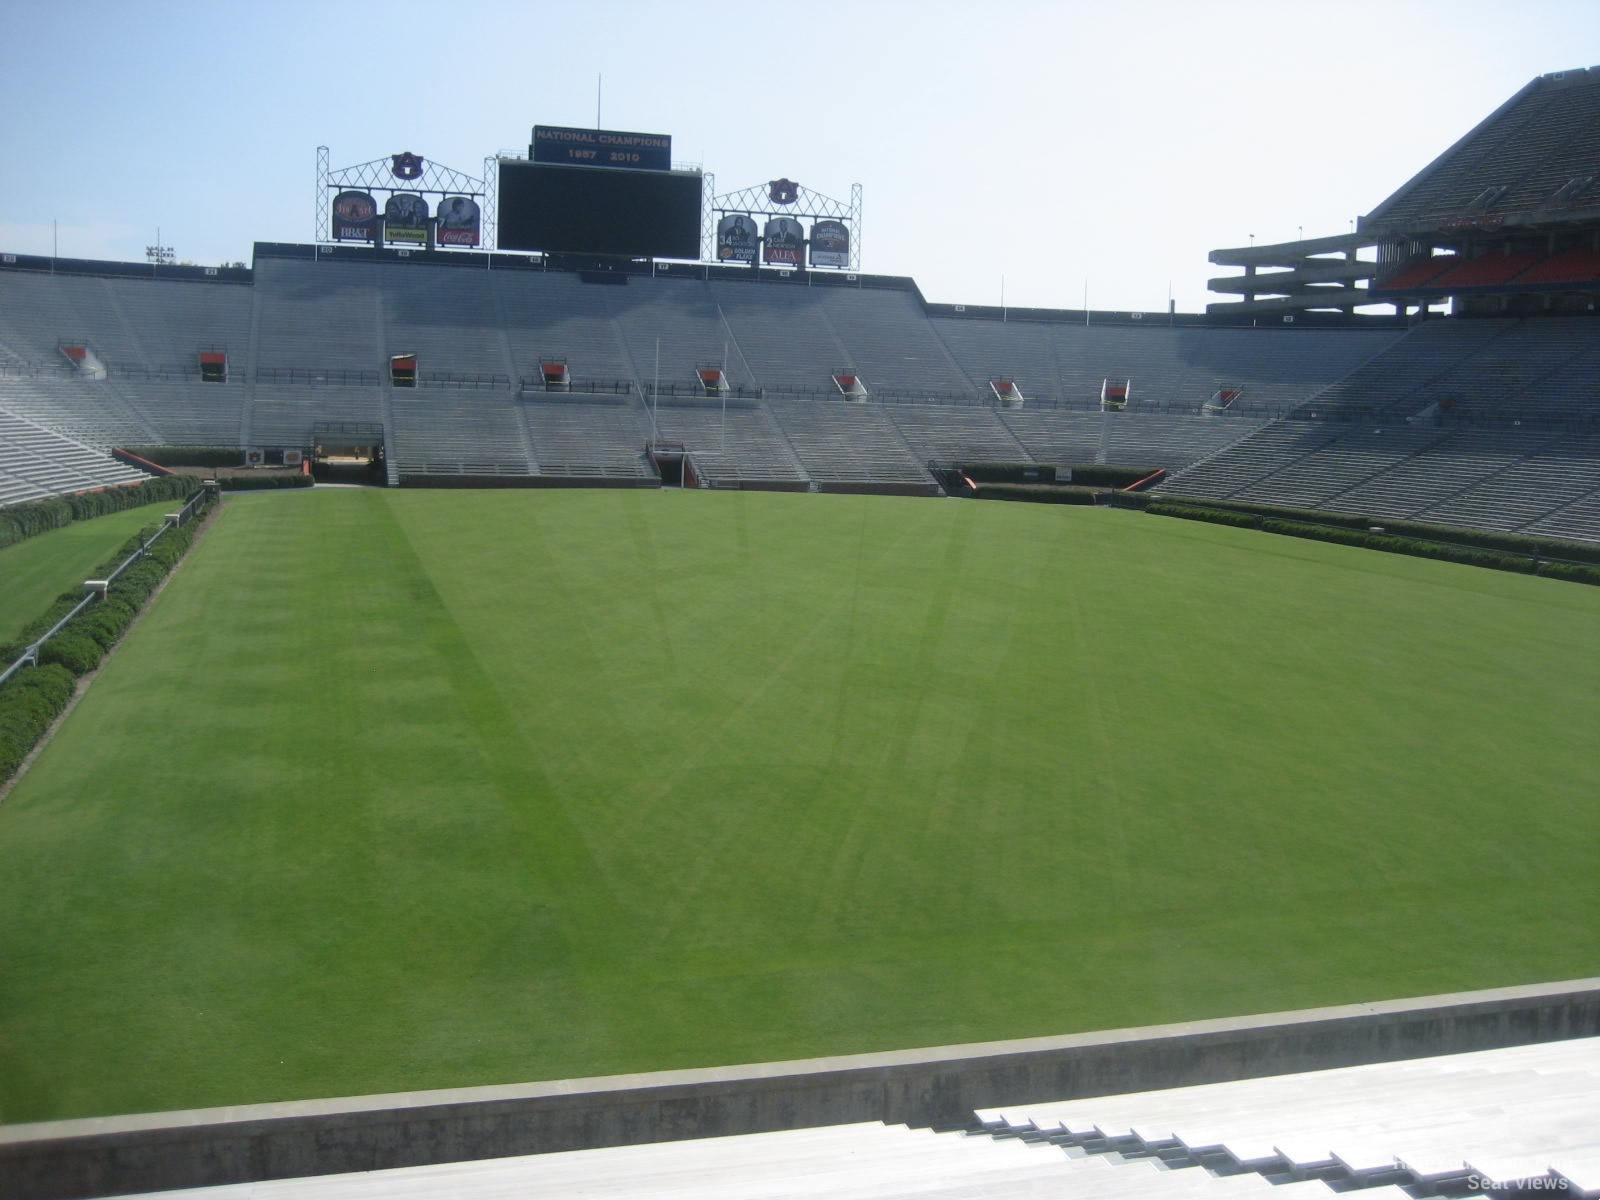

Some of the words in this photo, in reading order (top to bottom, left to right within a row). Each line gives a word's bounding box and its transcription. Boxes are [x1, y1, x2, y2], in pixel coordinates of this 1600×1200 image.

[536, 129, 595, 143] NATIONAL
[598, 134, 670, 148] CHAMPIONS
[609, 151, 641, 162] 2010
[340, 227, 370, 239] BB&T
[719, 235, 733, 246] 34
[766, 237, 773, 249] 2
[770, 250, 797, 260] ALFA
